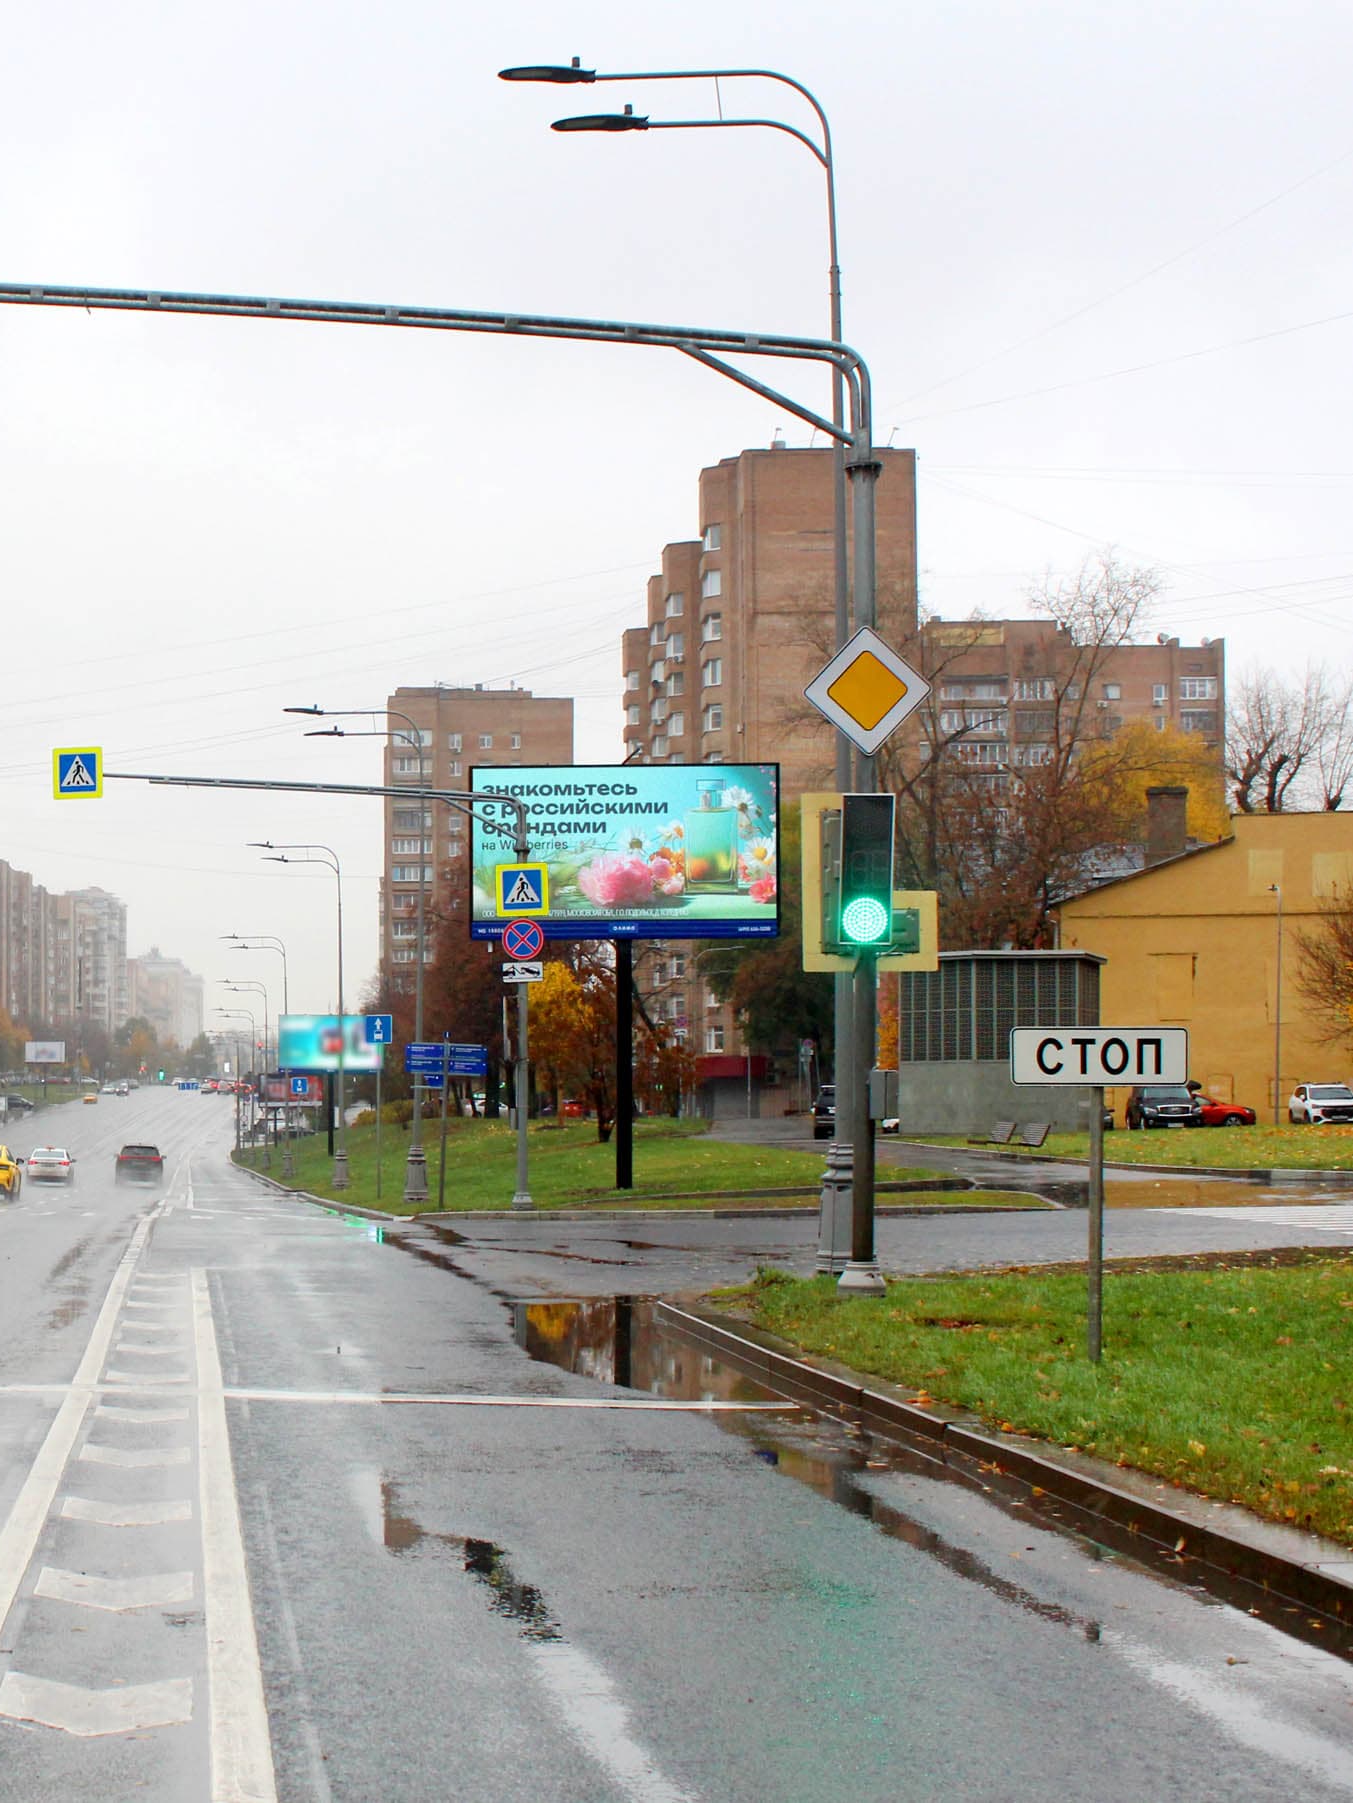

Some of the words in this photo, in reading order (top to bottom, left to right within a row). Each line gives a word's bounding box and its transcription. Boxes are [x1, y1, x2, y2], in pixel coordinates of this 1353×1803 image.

[482, 783, 638, 797] знакомьтесь
[482, 804, 496, 817] с
[482, 820, 607, 837] брндами
[481, 842, 496, 851] на
[499, 838, 569, 851] Wiberries
[1036, 1037, 1162, 1076] СТОП
